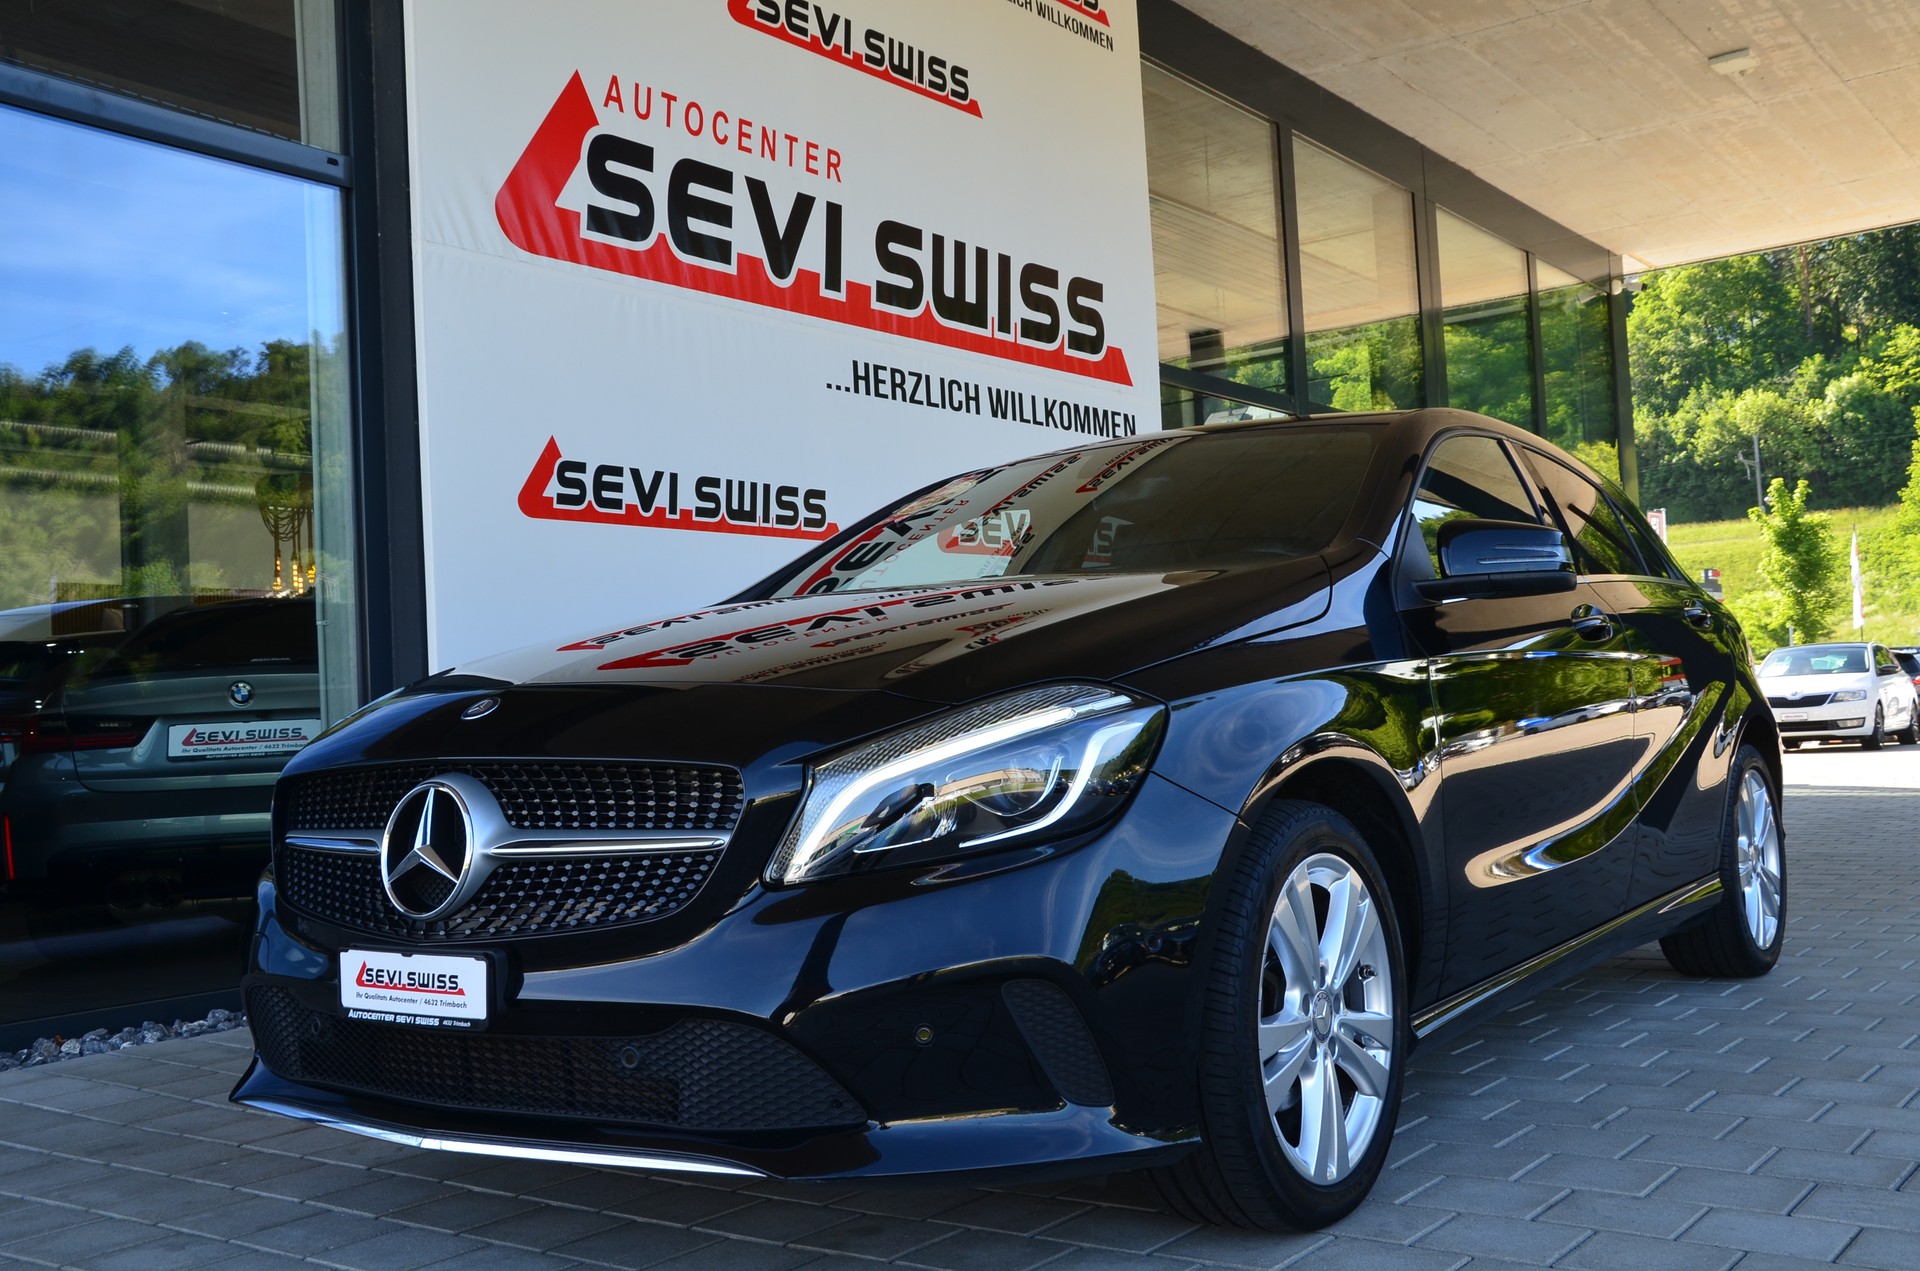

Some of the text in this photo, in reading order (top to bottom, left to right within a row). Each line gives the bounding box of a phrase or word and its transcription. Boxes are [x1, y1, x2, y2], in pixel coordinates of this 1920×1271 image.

[755, 0, 970, 102] SEVI SWISS
[1036, 0, 1114, 52] WILLKOMMEN
[602, 75, 843, 183] AUTOCENTER
[585, 132, 1106, 356] SEVI SWISS
[987, 386, 1137, 438] WILLKOMMEN
[555, 459, 827, 529] SEVI SWISS
[195, 727, 303, 743] SEVI SWISS
[364, 967, 459, 991] SEVI SWISS
[389, 994, 419, 1005] Autocenter
[423, 998, 439, 1006] 4632
[440, 999, 468, 1009] Trimbach
[396, 1014, 414, 1024] SEVI
[415, 1016, 440, 1026] SWISS
